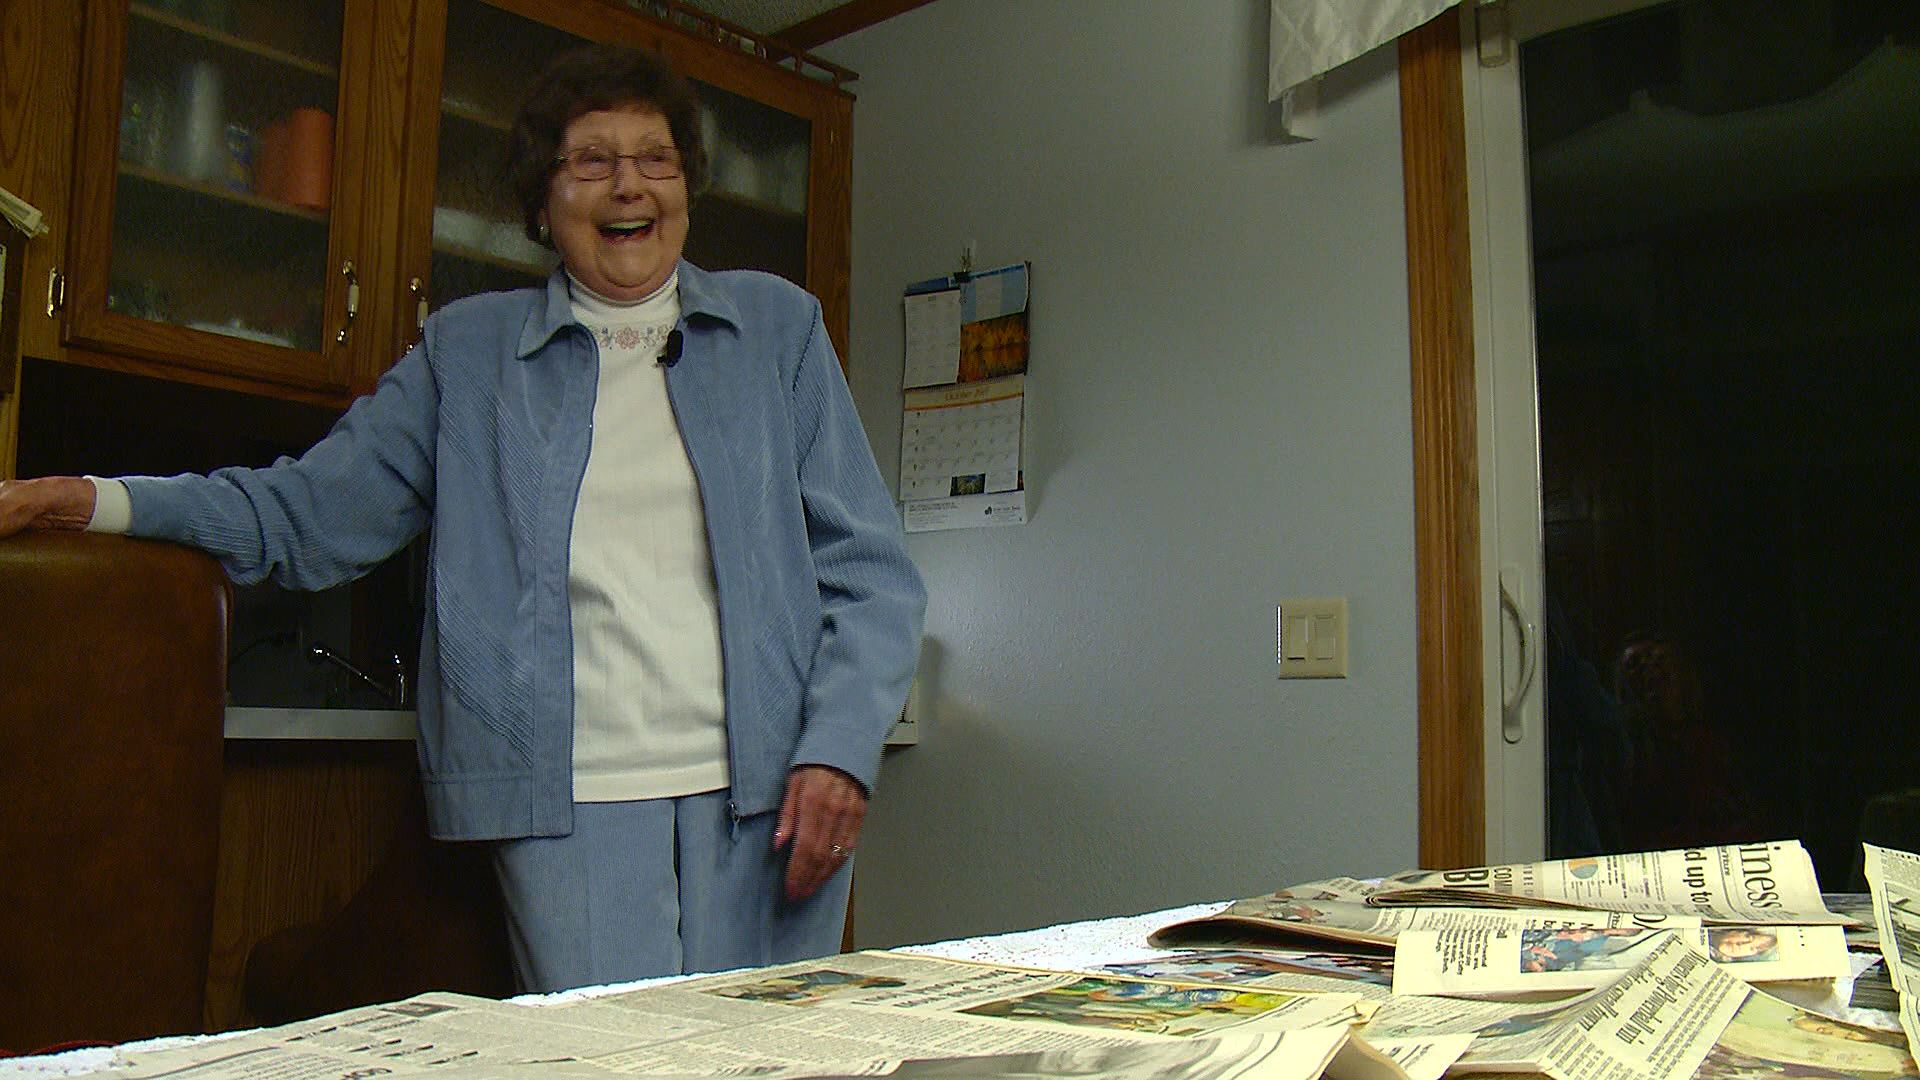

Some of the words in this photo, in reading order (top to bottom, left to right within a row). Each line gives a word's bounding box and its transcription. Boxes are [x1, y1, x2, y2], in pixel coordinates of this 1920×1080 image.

[1682, 866, 1707, 888] up
[1690, 891, 1713, 904] to
[1670, 948, 1709, 987] Women's
[1655, 974, 1688, 995] big
[1628, 986, 1678, 1035] Powerball
[1615, 1022, 1645, 1045] win
